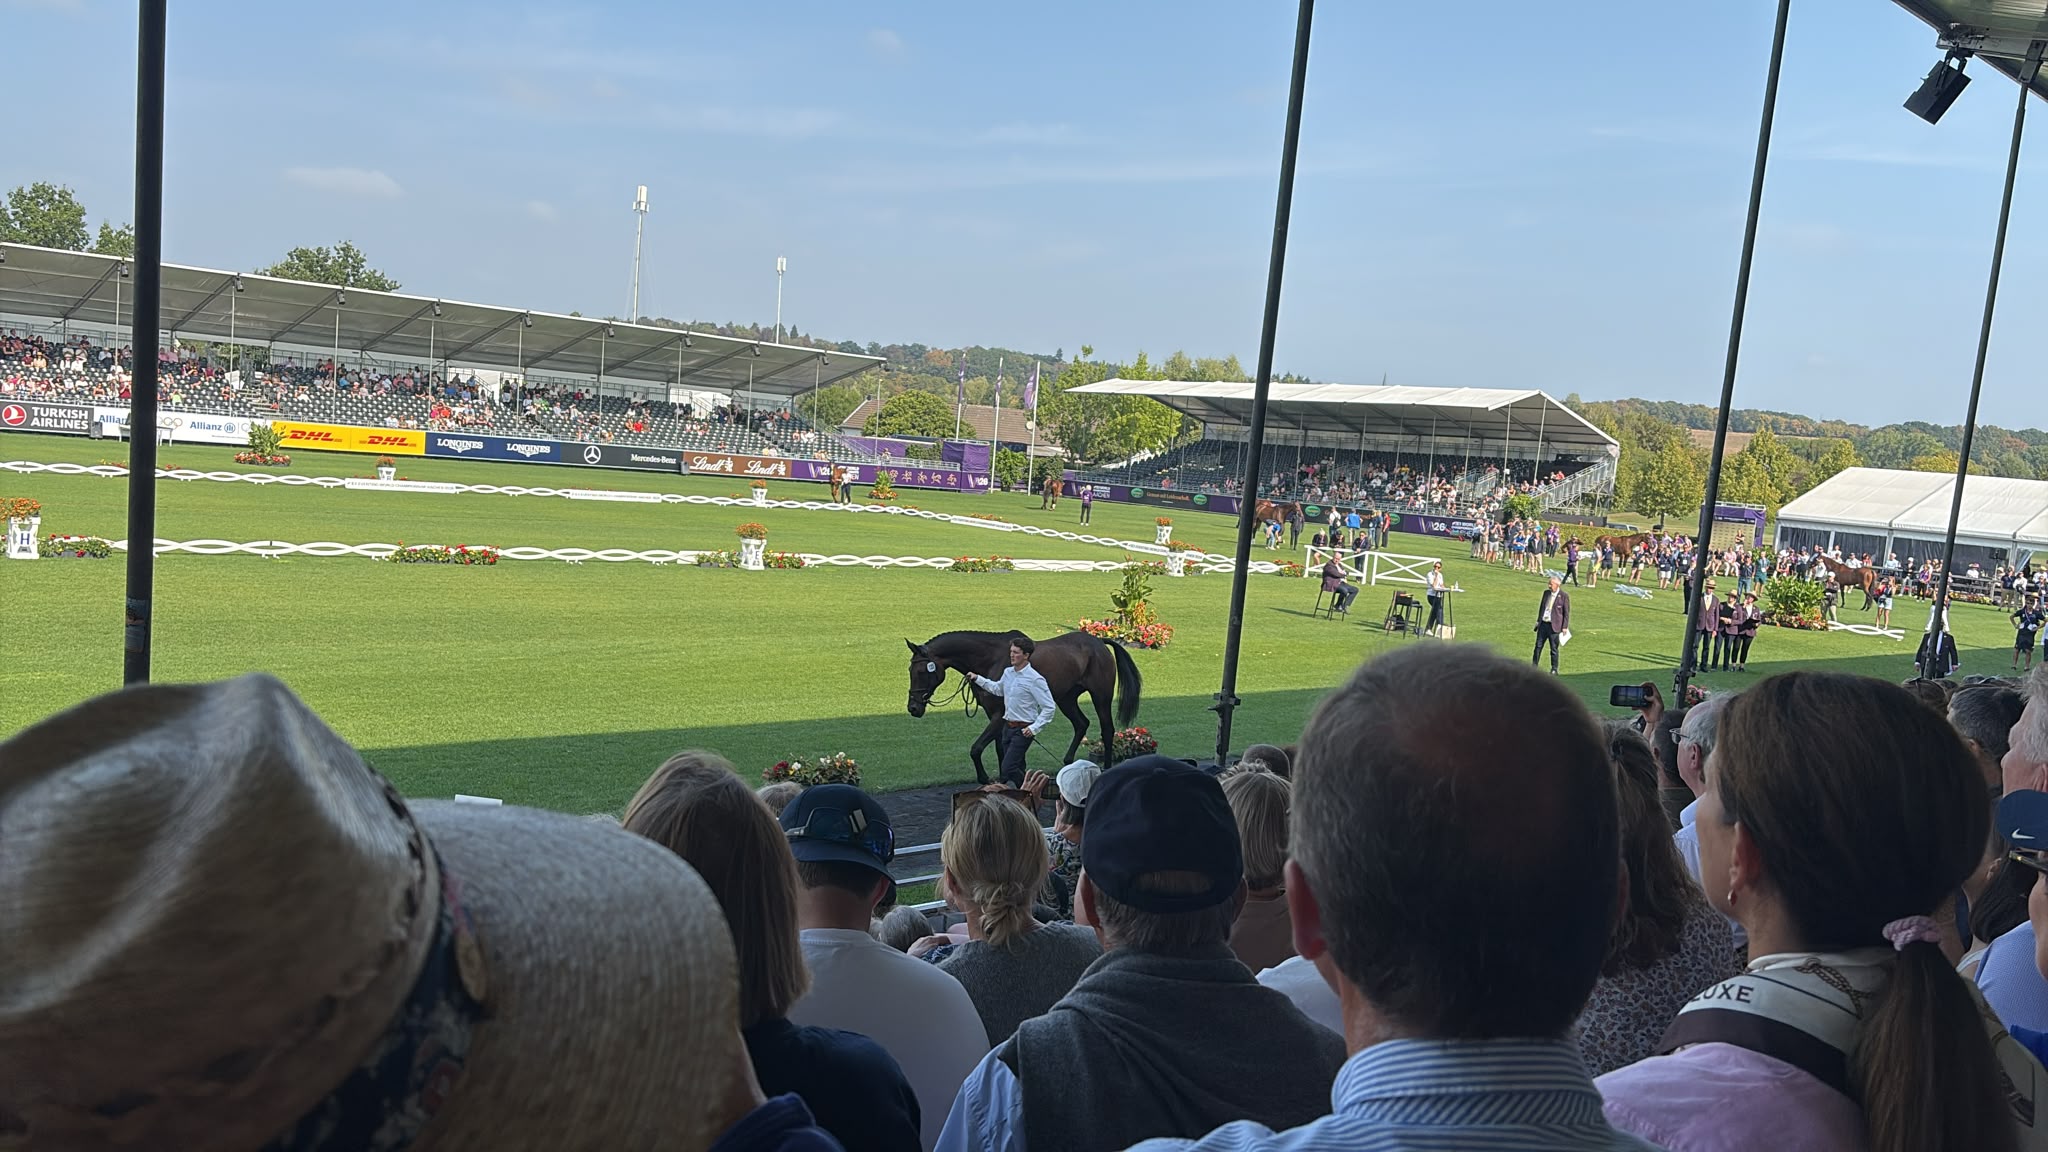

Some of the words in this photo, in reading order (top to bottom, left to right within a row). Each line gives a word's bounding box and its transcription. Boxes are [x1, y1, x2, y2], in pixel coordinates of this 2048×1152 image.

[31, 406, 89, 420] TURKISH
[30, 417, 89, 430] AIRLINES
[189, 421, 222, 431] Allianz
[289, 430, 334, 441] DHL
[367, 435, 409, 447] DHL
[437, 438, 484, 450] LONGINES
[506, 443, 551, 454] LONGINES
[630, 453, 677, 464] Mercedes-Benz
[689, 455, 726, 471] Lindt
[743, 460, 778, 475] Lindt
[20, 532, 30, 545] H
